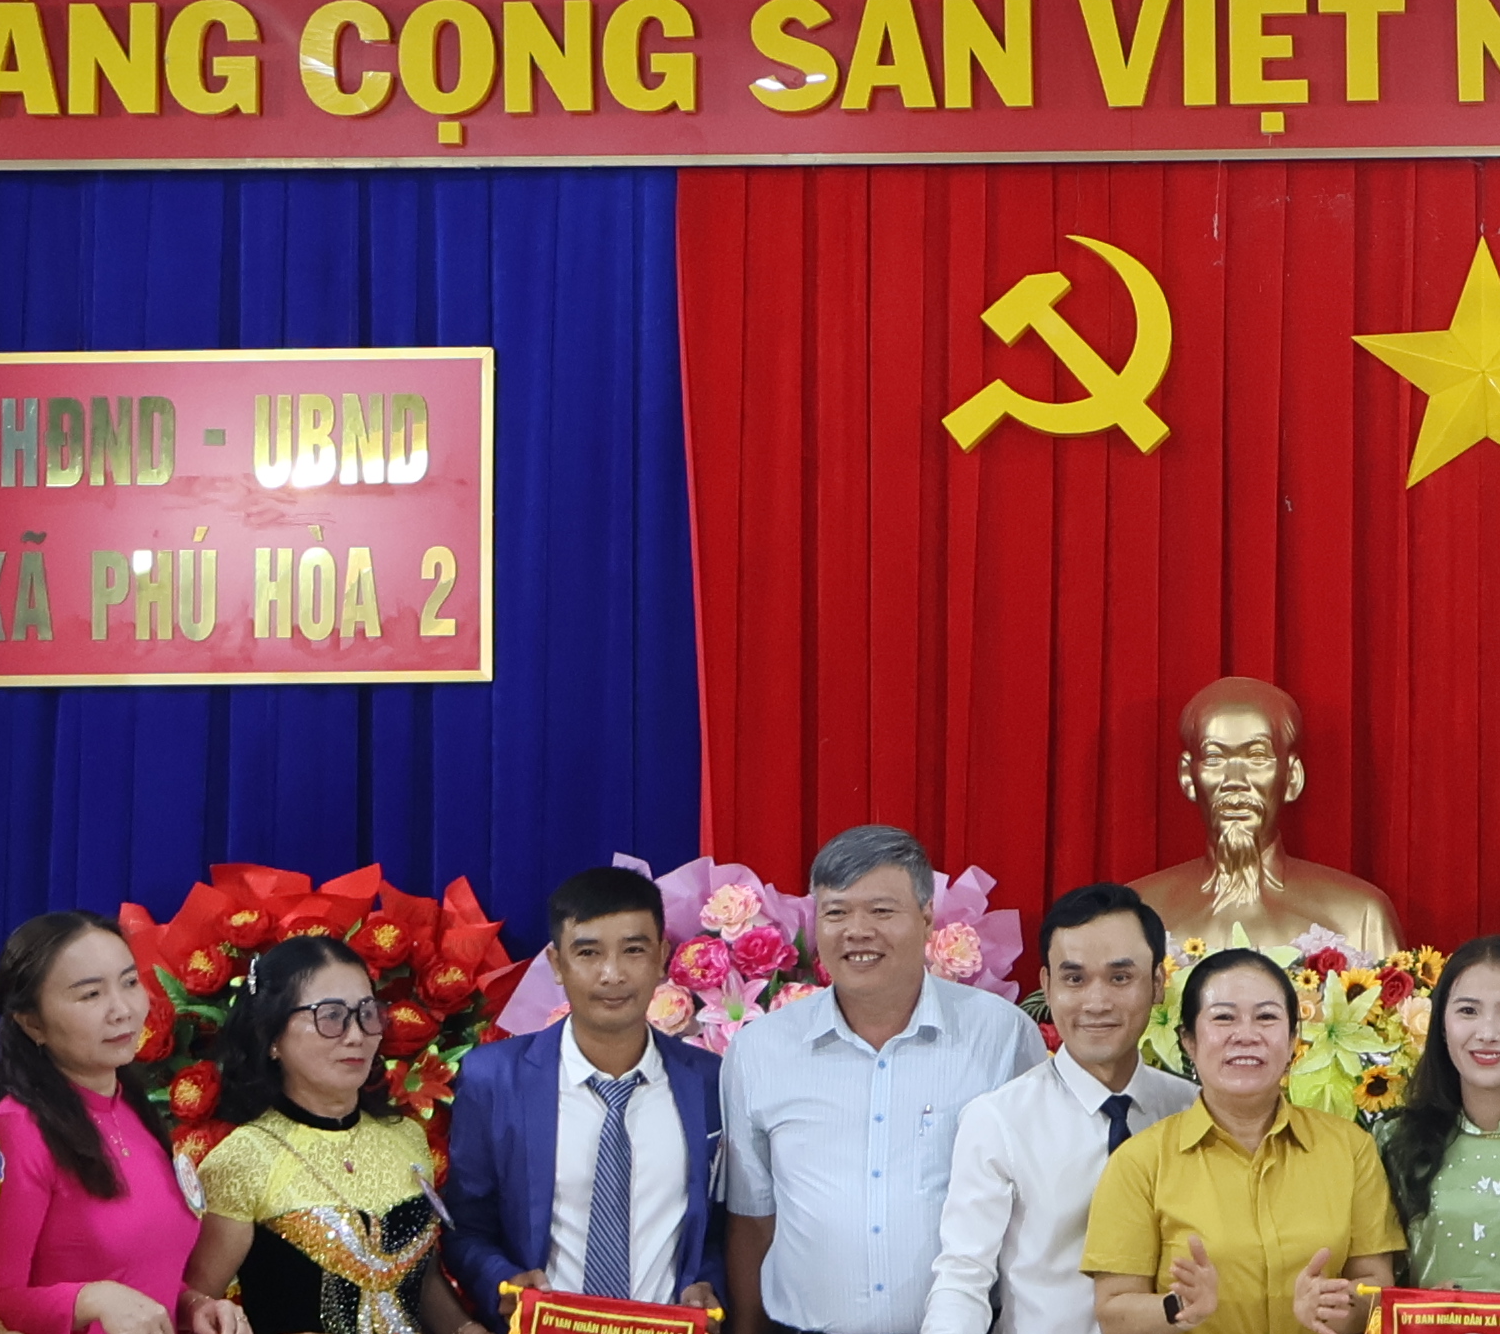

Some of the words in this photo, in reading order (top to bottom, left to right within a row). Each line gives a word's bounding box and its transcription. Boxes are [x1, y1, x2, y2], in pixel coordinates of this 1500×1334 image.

[0, 395, 176, 487] HĐND
[254, 393, 429, 488] UBND
[91, 526, 218, 642] PHÚ
[254, 524, 382, 641] HÒA
[420, 545, 457, 636] 2
